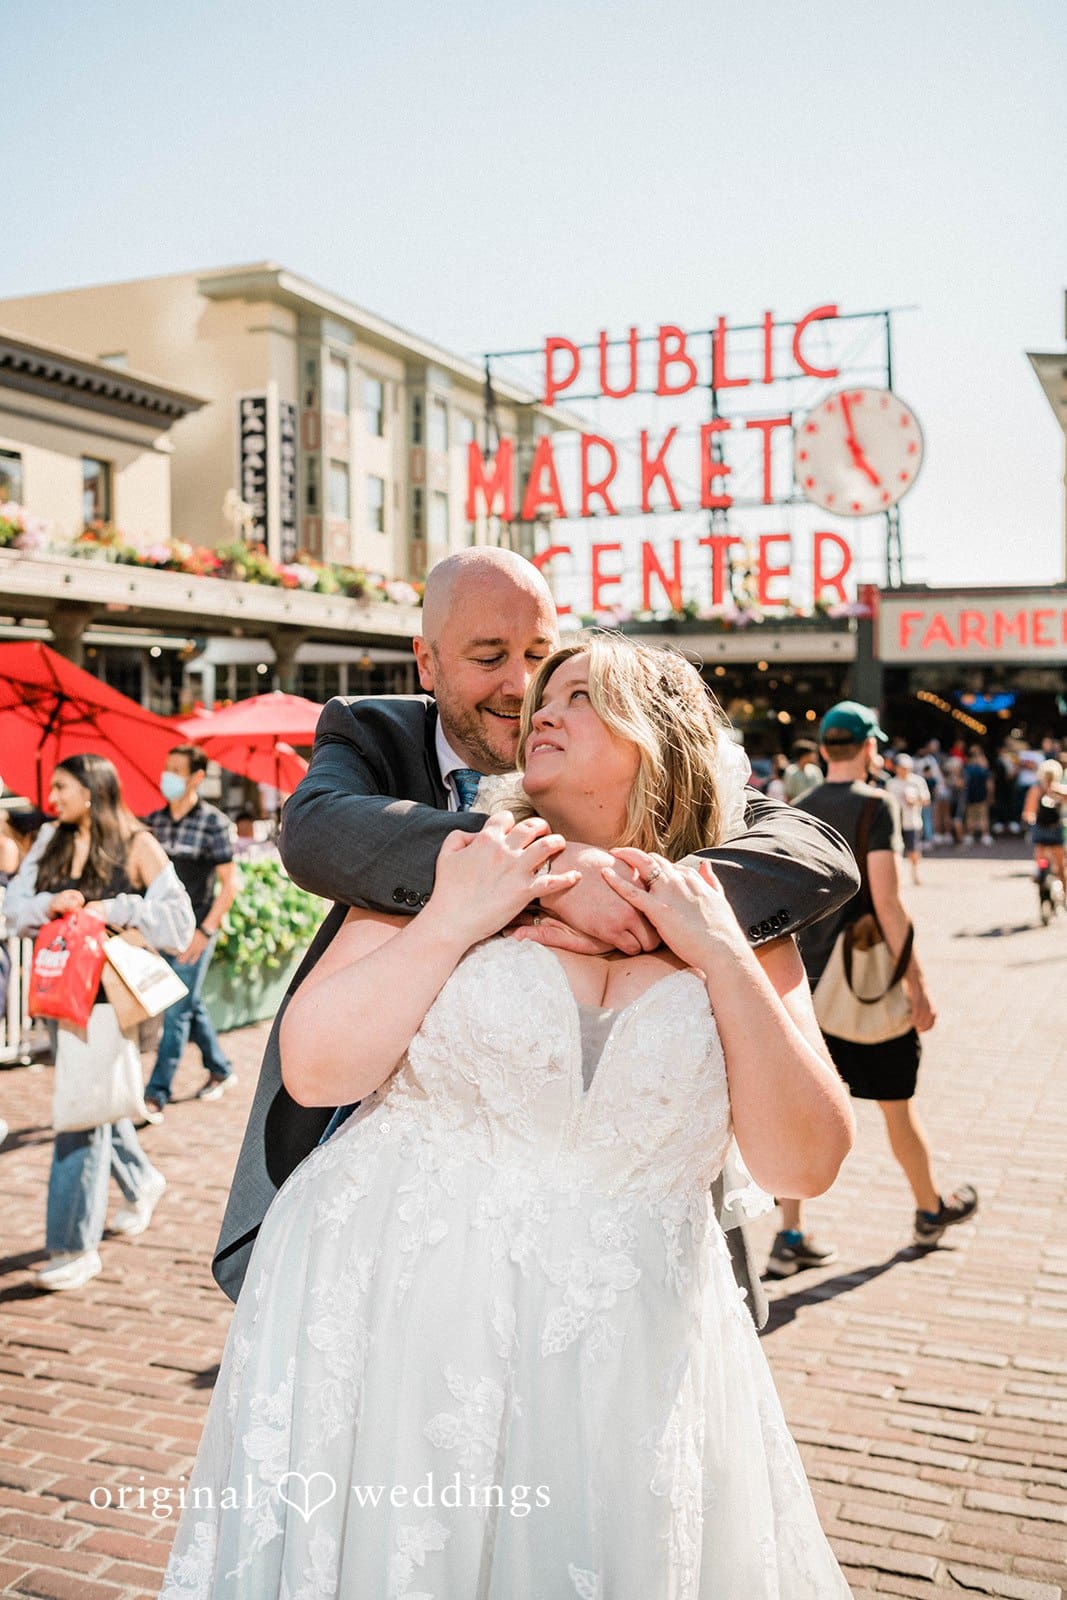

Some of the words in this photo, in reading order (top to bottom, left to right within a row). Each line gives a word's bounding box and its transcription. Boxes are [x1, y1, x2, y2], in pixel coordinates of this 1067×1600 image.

[544, 304, 838, 406] PUBLIC
[466, 416, 793, 521] MARKET
[898, 609, 1067, 650] FARME
